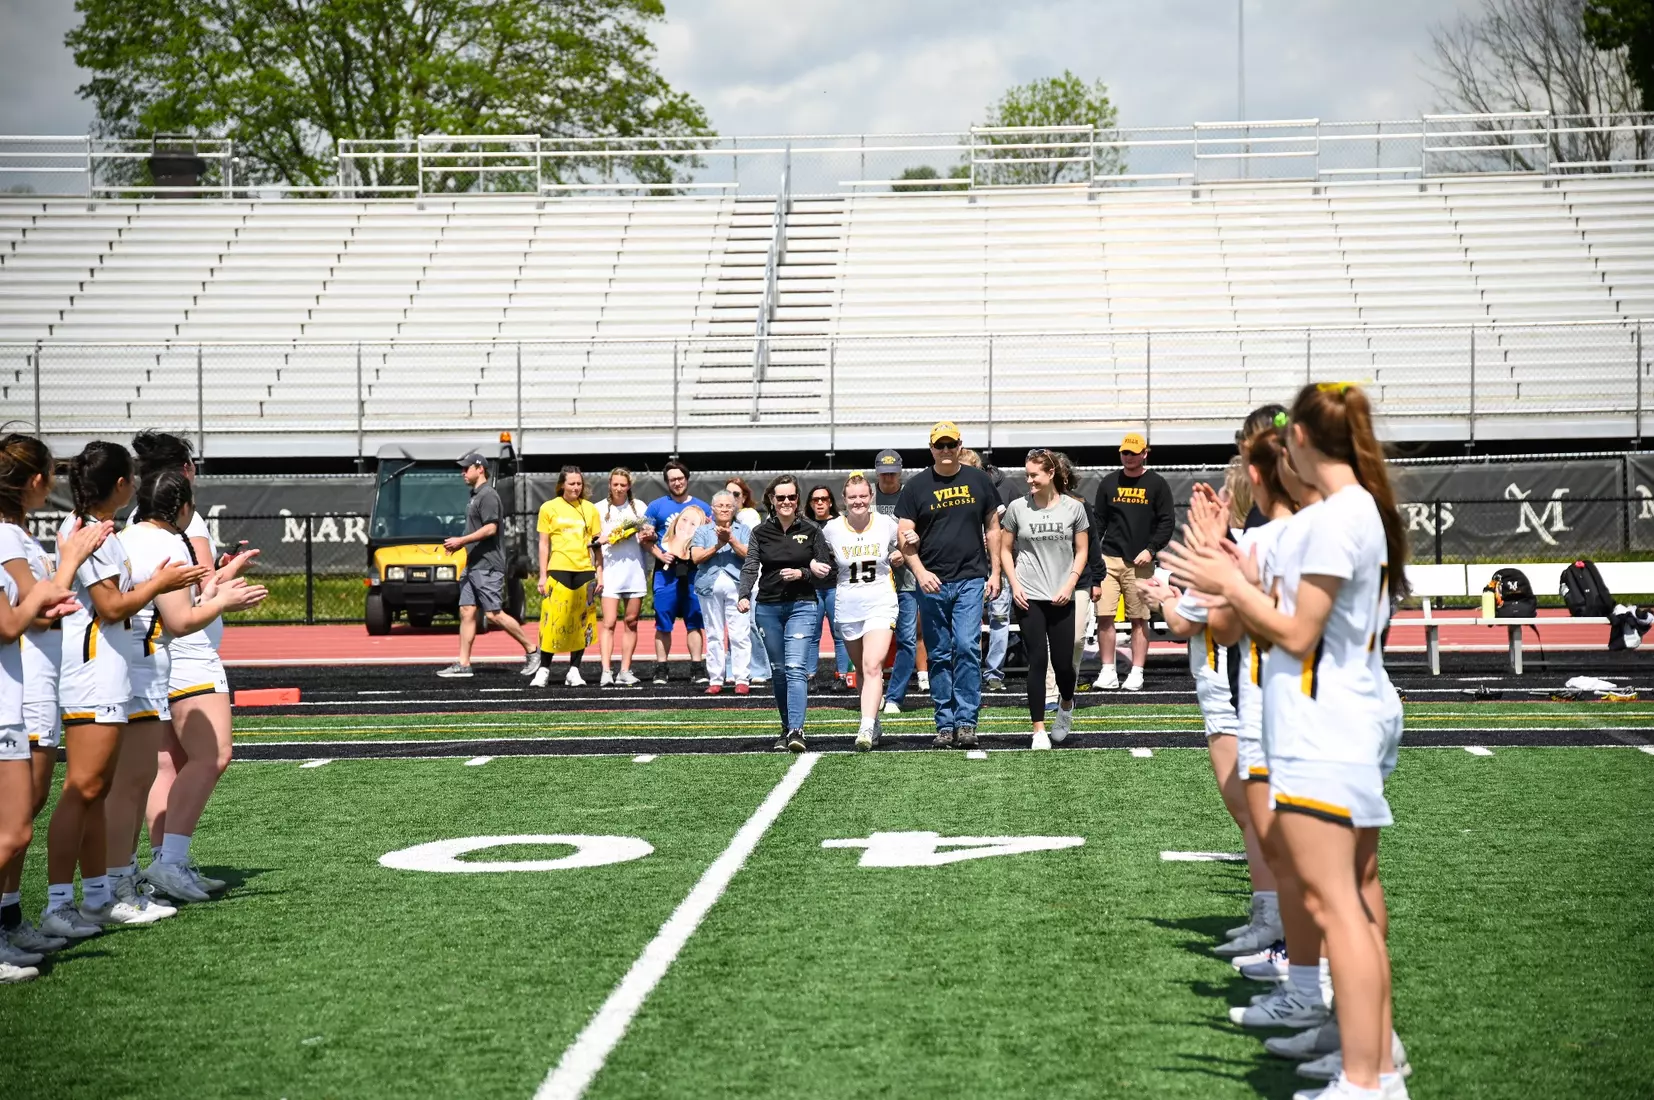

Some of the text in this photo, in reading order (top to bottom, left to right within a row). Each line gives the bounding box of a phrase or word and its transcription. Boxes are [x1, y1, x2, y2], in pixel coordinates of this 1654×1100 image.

[933, 485, 971, 502] VILLE
[1116, 486, 1147, 500] VILLE
[929, 497, 977, 511] LACROSSE
[1112, 496, 1150, 505] LACROSSE
[1028, 522, 1065, 535] VILLE
[848, 560, 878, 584] 15
